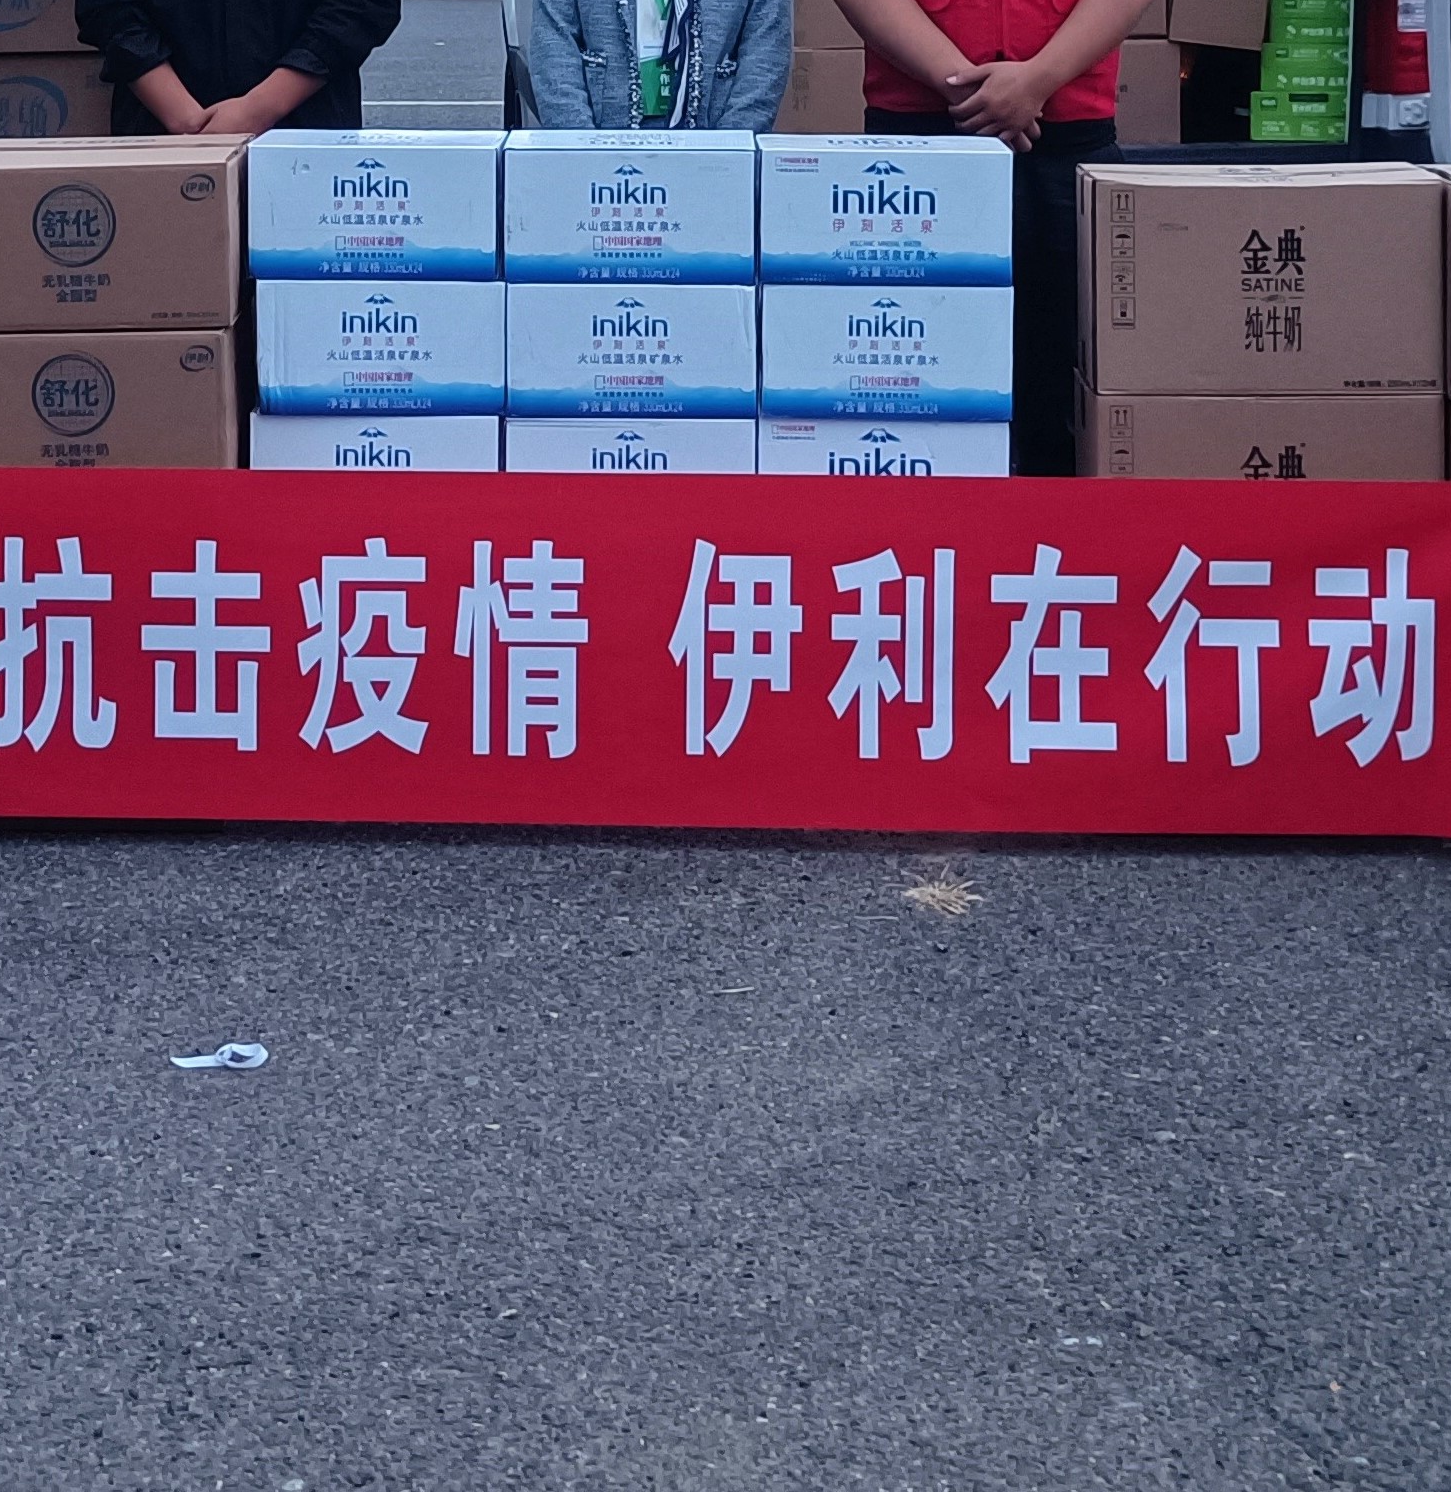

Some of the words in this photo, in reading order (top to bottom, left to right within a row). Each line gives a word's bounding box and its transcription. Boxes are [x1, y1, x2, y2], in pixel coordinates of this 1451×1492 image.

[185, 180, 211, 195] 伊利
[333, 171, 409, 198] inikin
[590, 178, 667, 205] inikin
[831, 179, 936, 215] inikin
[40, 208, 101, 239] 舒化
[318, 214, 424, 226] 火山低温活泉矿泉水
[576, 221, 681, 232] 火山低温活泉矿泉水
[832, 218, 933, 233] 伊刻活泉
[347, 236, 405, 247] 中国国家地理
[604, 236, 662, 247] 中国国家地理
[1240, 228, 1306, 275] 金典
[831, 249, 938, 261] 火山低温活泉矿泉水
[1241, 277, 1305, 292] SATINE
[341, 307, 417, 334] inikin
[592, 311, 668, 337] inikin
[848, 311, 924, 338] inikin
[1244, 306, 1302, 352] 纯牛奶
[326, 349, 433, 361] 火山低温活泉矿泉水
[577, 353, 684, 365] 火山低温活泉矿泉水
[832, 353, 939, 365] 火山低温活泉矿泉水
[355, 371, 414, 383] 中国国家地理
[606, 375, 664, 386] 中国国家地理
[861, 376, 920, 388] 中国国家地理
[39, 378, 100, 409] 舒化
[334, 441, 411, 467] inikin
[591, 444, 668, 470] inikin
[828, 447, 932, 476] inikin
[668, 538, 1437, 768] 伊利在行动
